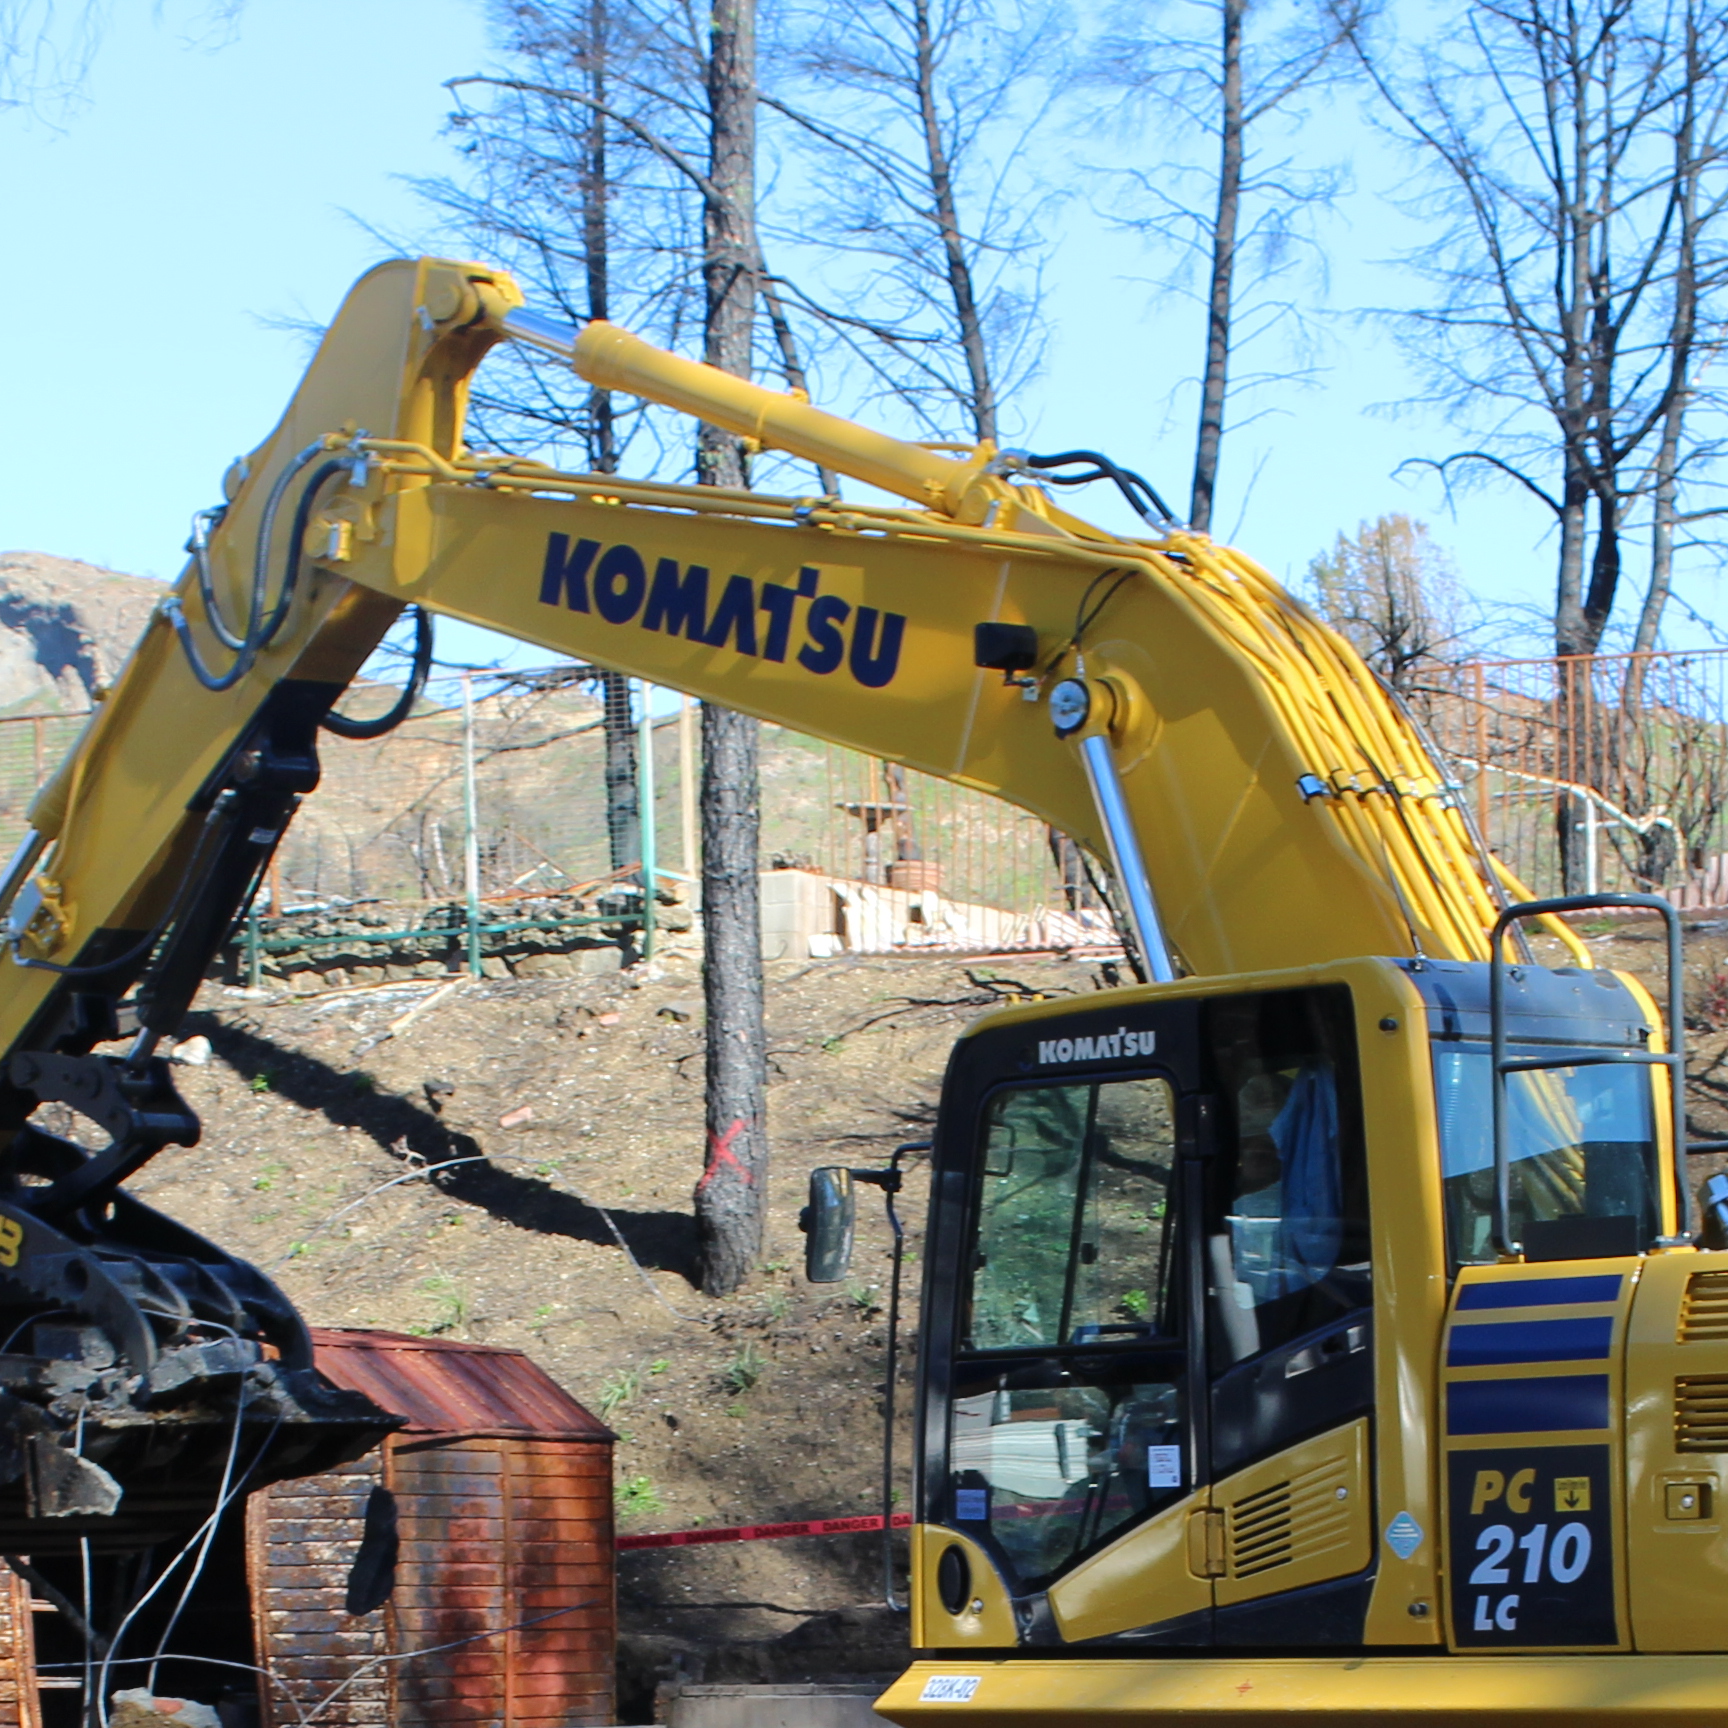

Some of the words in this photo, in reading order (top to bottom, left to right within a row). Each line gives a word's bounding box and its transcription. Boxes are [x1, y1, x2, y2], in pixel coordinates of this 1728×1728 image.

[539, 532, 906, 688] KOMATSU
[1038, 1027, 1156, 1065] KOMATSU
[1470, 1468, 1535, 1515] PC
[754, 1523, 811, 1537] DANGER
[823, 1518, 878, 1533] DANGER
[1469, 1522, 1592, 1585] 210
[1474, 1595, 1520, 1631] LC
